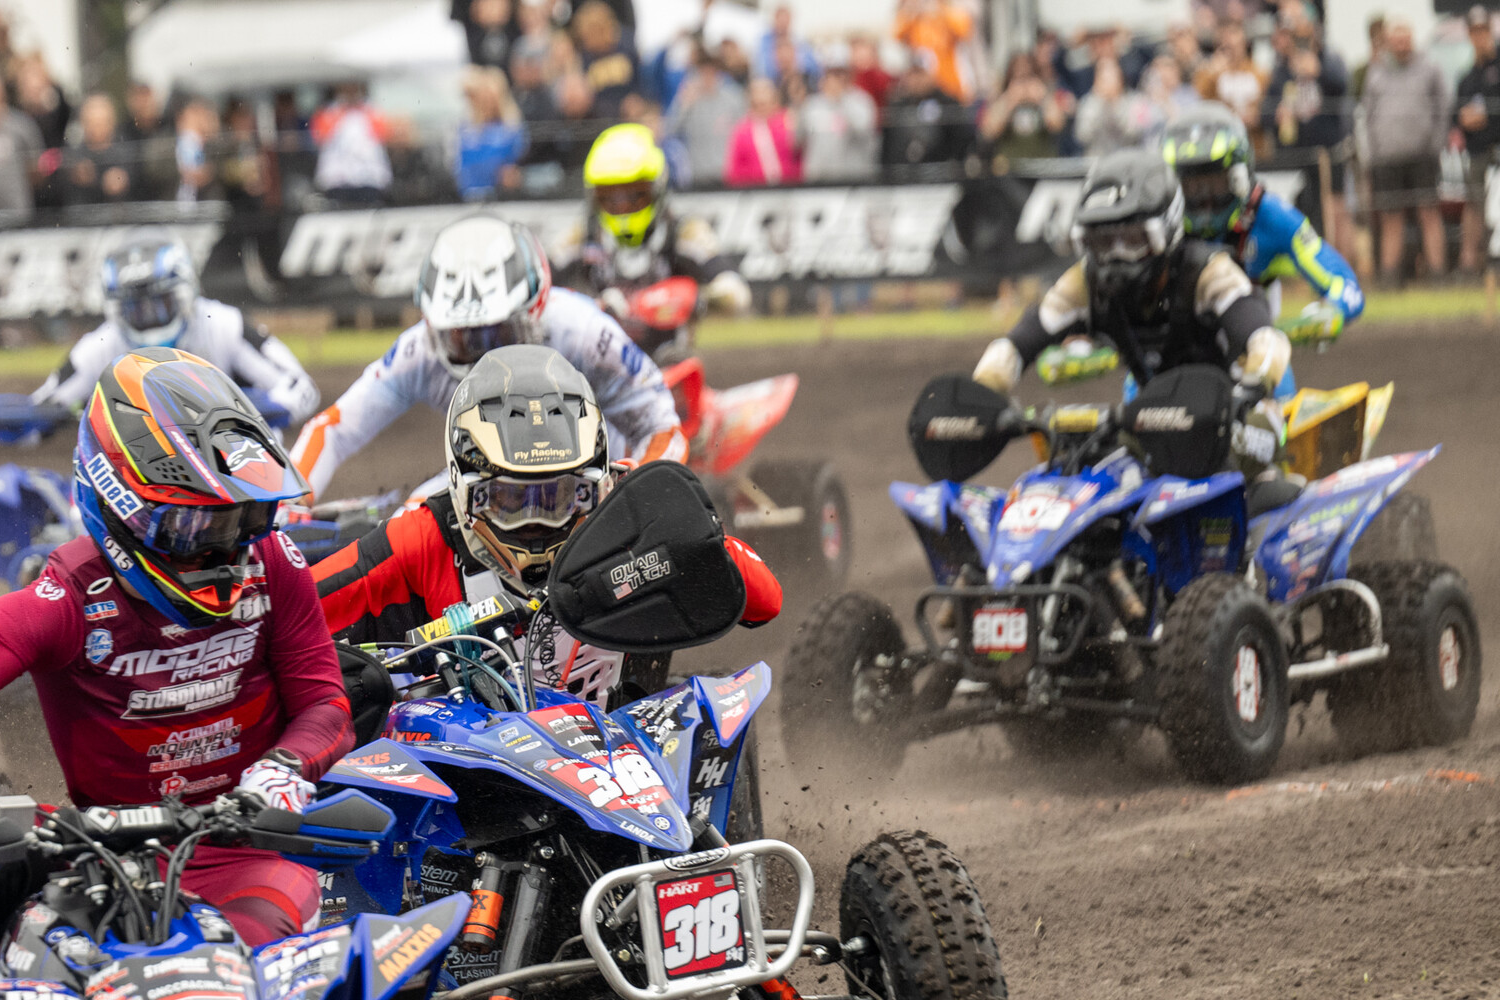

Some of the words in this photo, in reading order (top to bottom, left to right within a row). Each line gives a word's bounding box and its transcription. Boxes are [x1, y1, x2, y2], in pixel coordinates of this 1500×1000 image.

[514, 451, 529, 462] Fly
[610, 552, 659, 584] QUAD
[86, 602, 117, 614] ARTS
[106, 621, 263, 677] MOOSE
[170, 650, 254, 683] RACING
[148, 724, 242, 756] MOUNTAIN
[175, 742, 219, 760] STATE
[567, 734, 601, 748] LANDA
[336, 752, 391, 766] AXXIS
[577, 753, 664, 808] 318
[620, 820, 656, 843] LANDA
[659, 882, 702, 899] HART
[664, 889, 740, 970] 318
[378, 923, 443, 982] MAXXIS
[454, 968, 496, 980] FLASHIN
